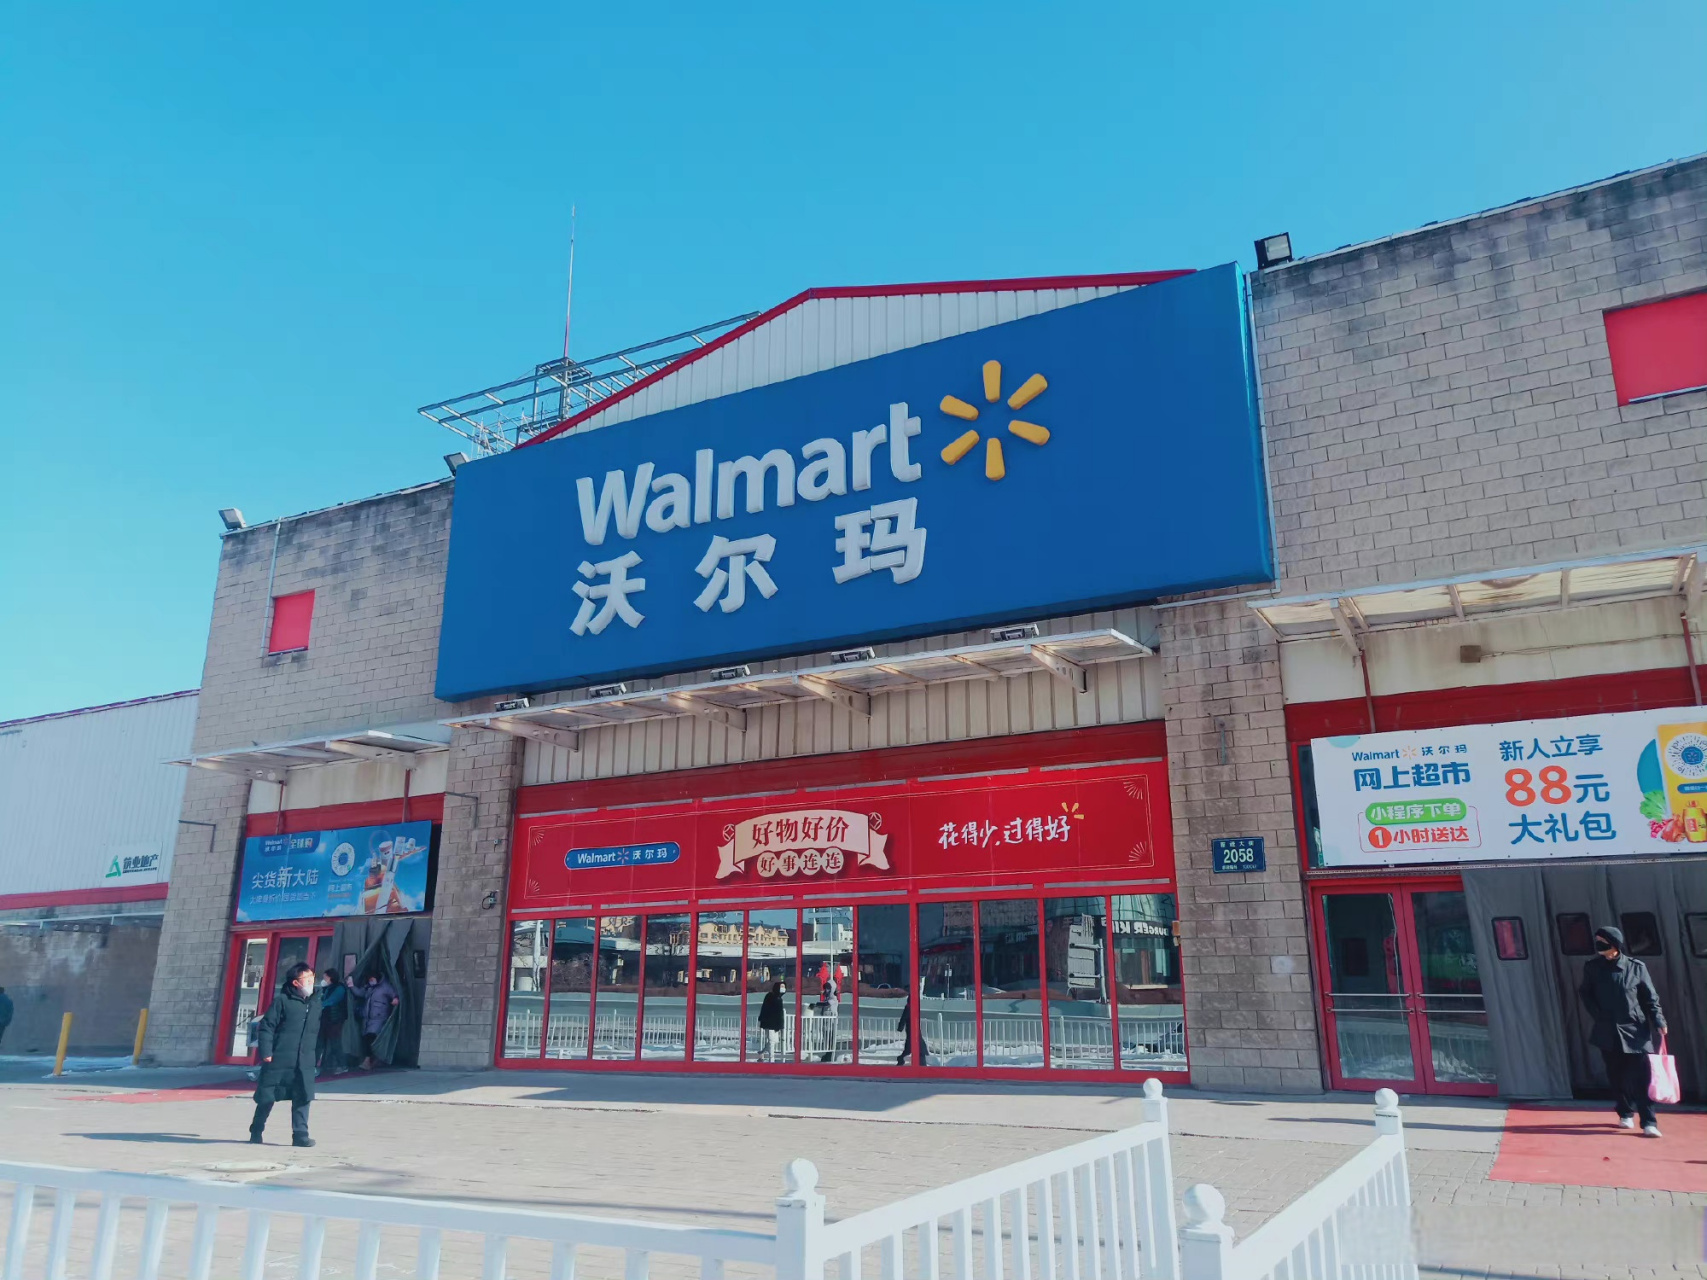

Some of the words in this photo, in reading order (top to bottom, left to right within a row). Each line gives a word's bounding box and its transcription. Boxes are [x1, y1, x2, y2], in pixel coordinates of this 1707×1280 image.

[576, 402, 922, 545] Walmart
[569, 497, 928, 636] 沃尔玛
[1352, 749, 1400, 762] Walmart
[1421, 744, 1468, 757] 沃尔玛
[1499, 734, 1604, 761] 新人立享
[1353, 761, 1471, 791] 网上超市
[1504, 765, 1611, 807] 88元
[1371, 803, 1461, 820] 小程序下单
[752, 816, 850, 848] 好物好价
[1508, 810, 1617, 845] 大礼包
[577, 852, 616, 864] Walmart
[632, 847, 668, 860] 沃尔玛
[760, 852, 842, 873] 好事连连
[1223, 848, 1254, 864] 2058
[251, 866, 319, 890] 尖货新大陆
